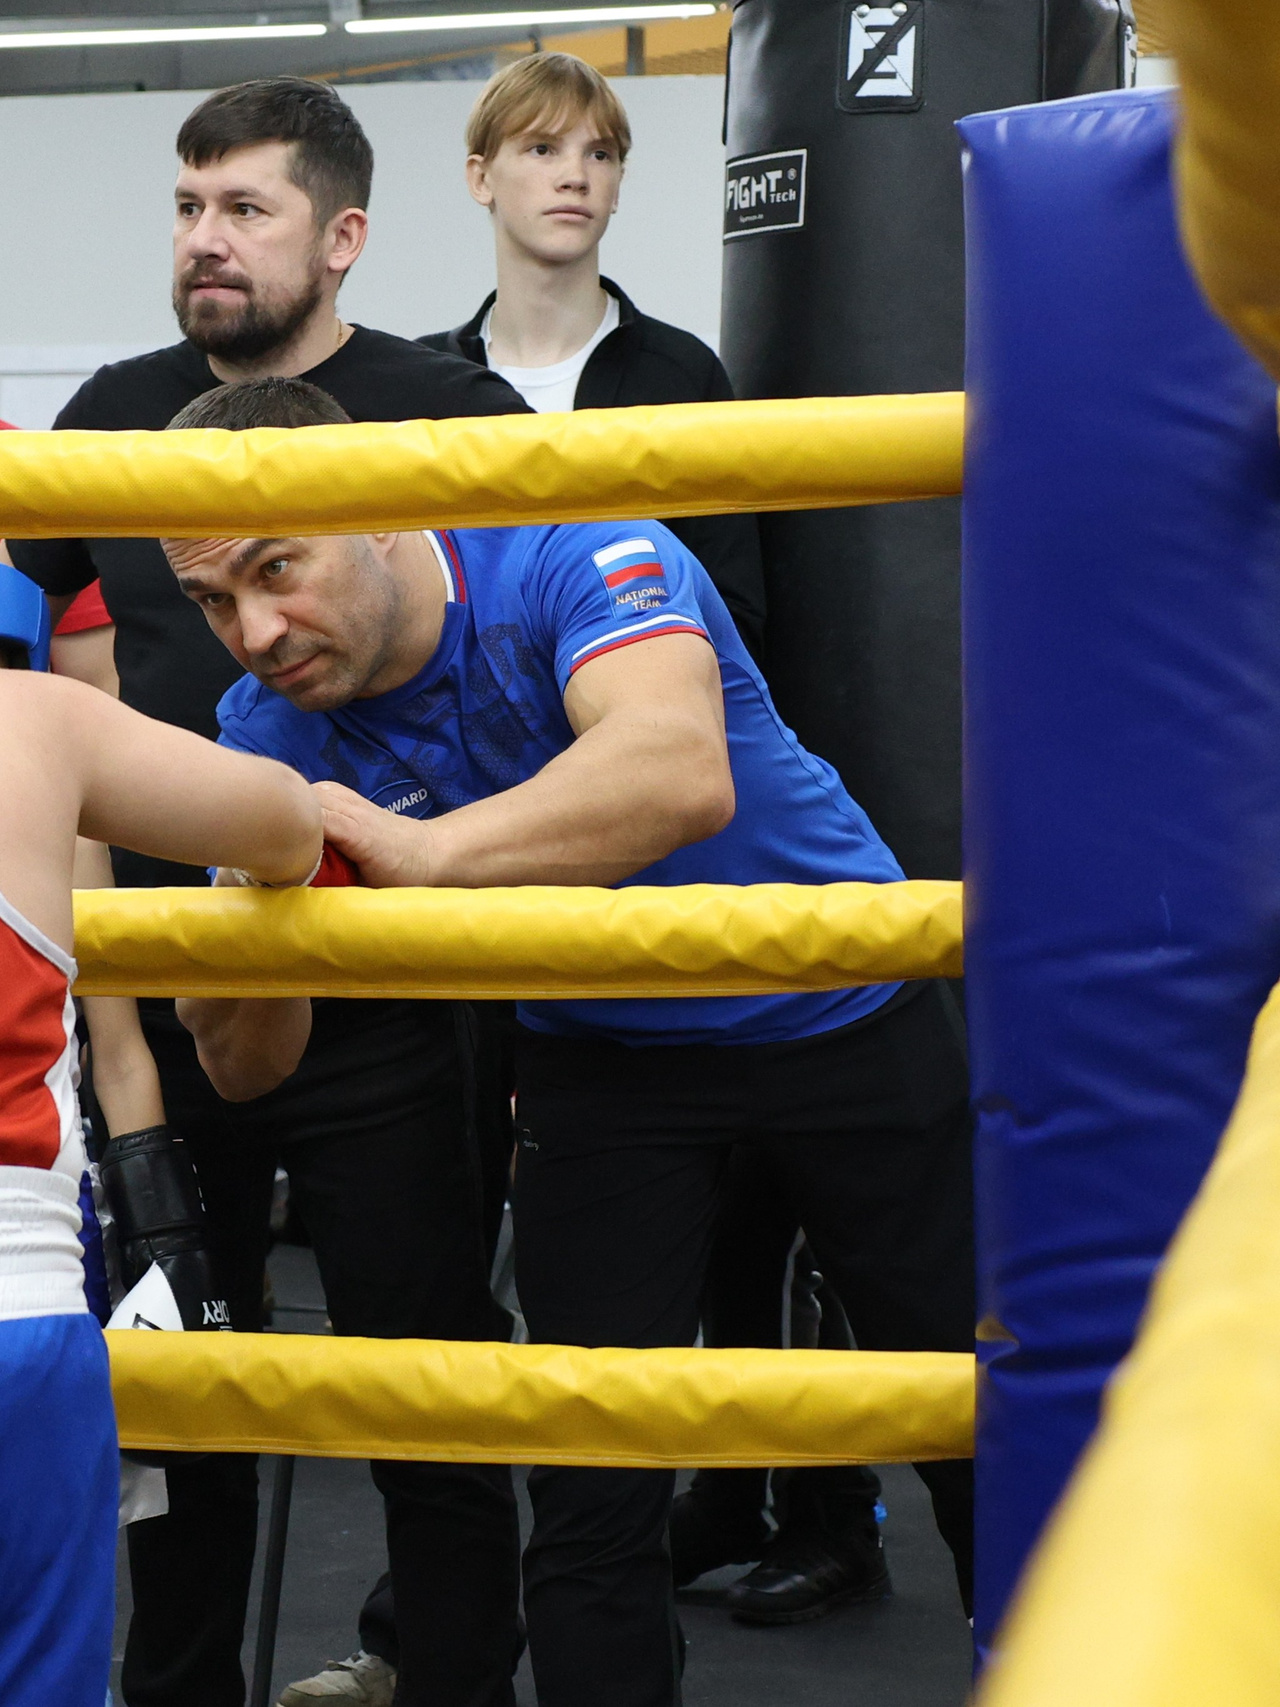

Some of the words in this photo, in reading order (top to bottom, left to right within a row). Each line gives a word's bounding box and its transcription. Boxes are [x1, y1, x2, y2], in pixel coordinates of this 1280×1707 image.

[726, 170, 782, 212] FIGHT
[615, 586, 668, 605] NATIONAL
[632, 599, 662, 611] TEAM
[383, 788, 428, 814] WARD
[202, 1300, 231, 1325] ORY
